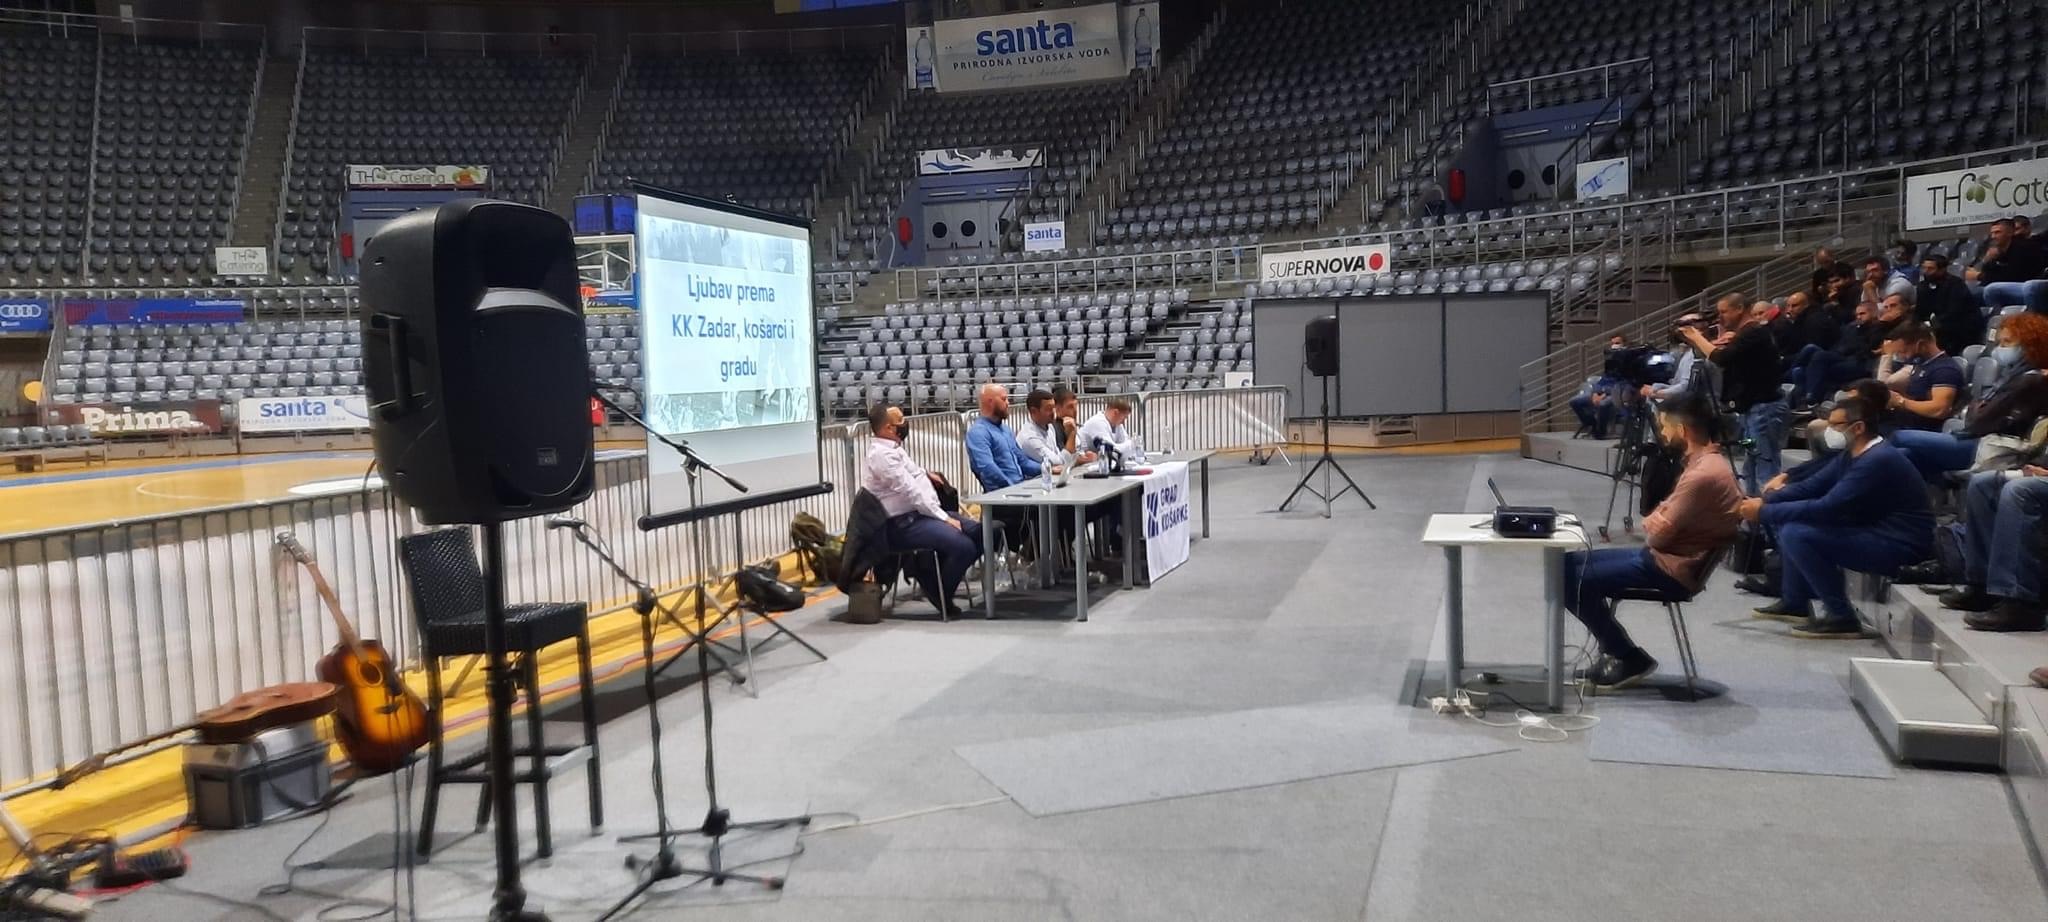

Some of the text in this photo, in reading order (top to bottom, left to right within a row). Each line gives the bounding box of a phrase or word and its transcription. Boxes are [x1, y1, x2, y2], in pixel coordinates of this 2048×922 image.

[976, 19, 1074, 56] santa
[953, 47, 1111, 70] PRIRODNA IZVORSKA VODA
[1027, 227, 1062, 240] santa
[1269, 255, 1366, 279] SUPERNOVA
[687, 273, 775, 305] Ljubav prema
[672, 313, 694, 337] KK
[698, 315, 741, 343] Zadar,
[744, 317, 788, 340] košarci
[720, 355, 757, 382] gradu
[80, 406, 193, 432] Prima
[260, 398, 327, 417] santa
[1160, 484, 1178, 507] GRAD
